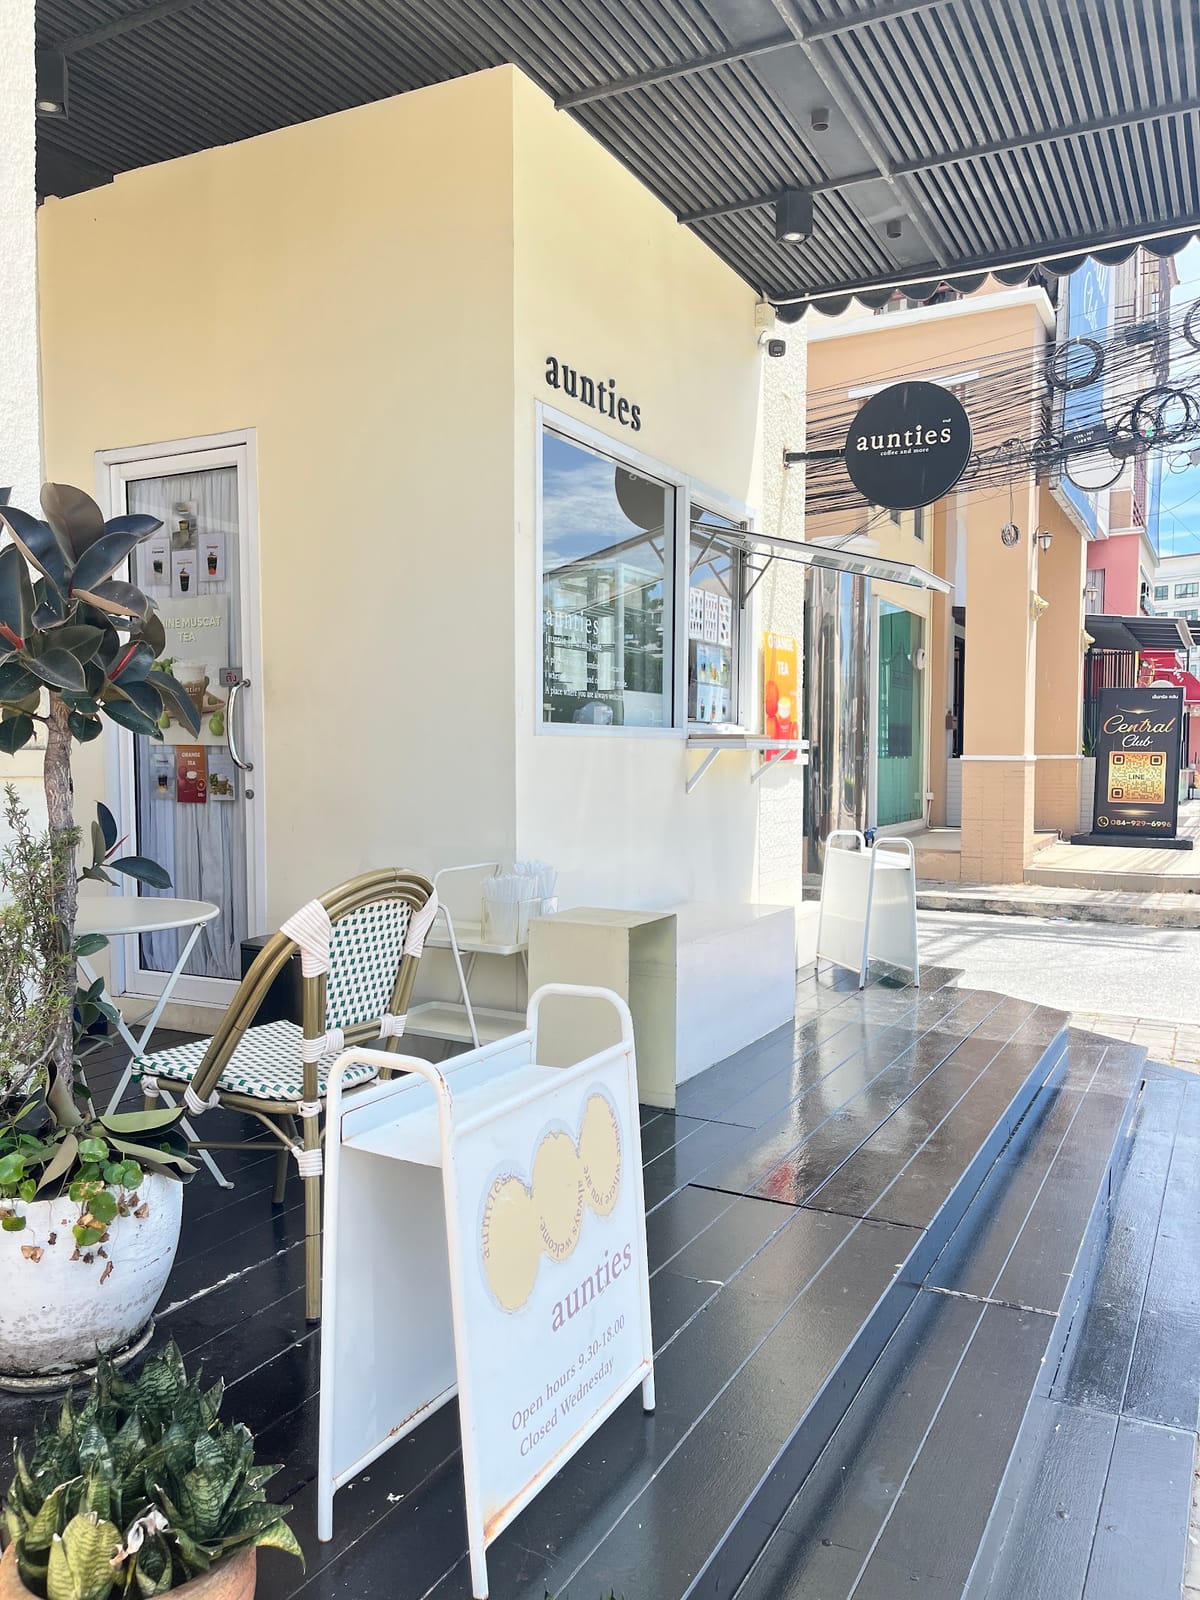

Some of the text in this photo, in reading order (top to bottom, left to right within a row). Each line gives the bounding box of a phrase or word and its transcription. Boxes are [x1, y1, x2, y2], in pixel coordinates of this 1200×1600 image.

[545, 356, 641, 431] aunties
[856, 424, 952, 451] aunties
[880, 449, 899, 457] coffee
[160, 616, 221, 630] INE MUSCAT
[180, 631, 197, 643] TEA
[776, 660, 790, 676] TEA
[1103, 714, 1177, 734] Central
[1122, 734, 1154, 748] Club
[583, 1165, 593, 1188] are
[572, 1180, 585, 1235] always
[591, 1188, 603, 1206] you
[551, 1243, 632, 1333] aunties
[512, 1314, 625, 1430] Open hours 9.30-18.00
[520, 1357, 615, 1457] Closed Wednesday
